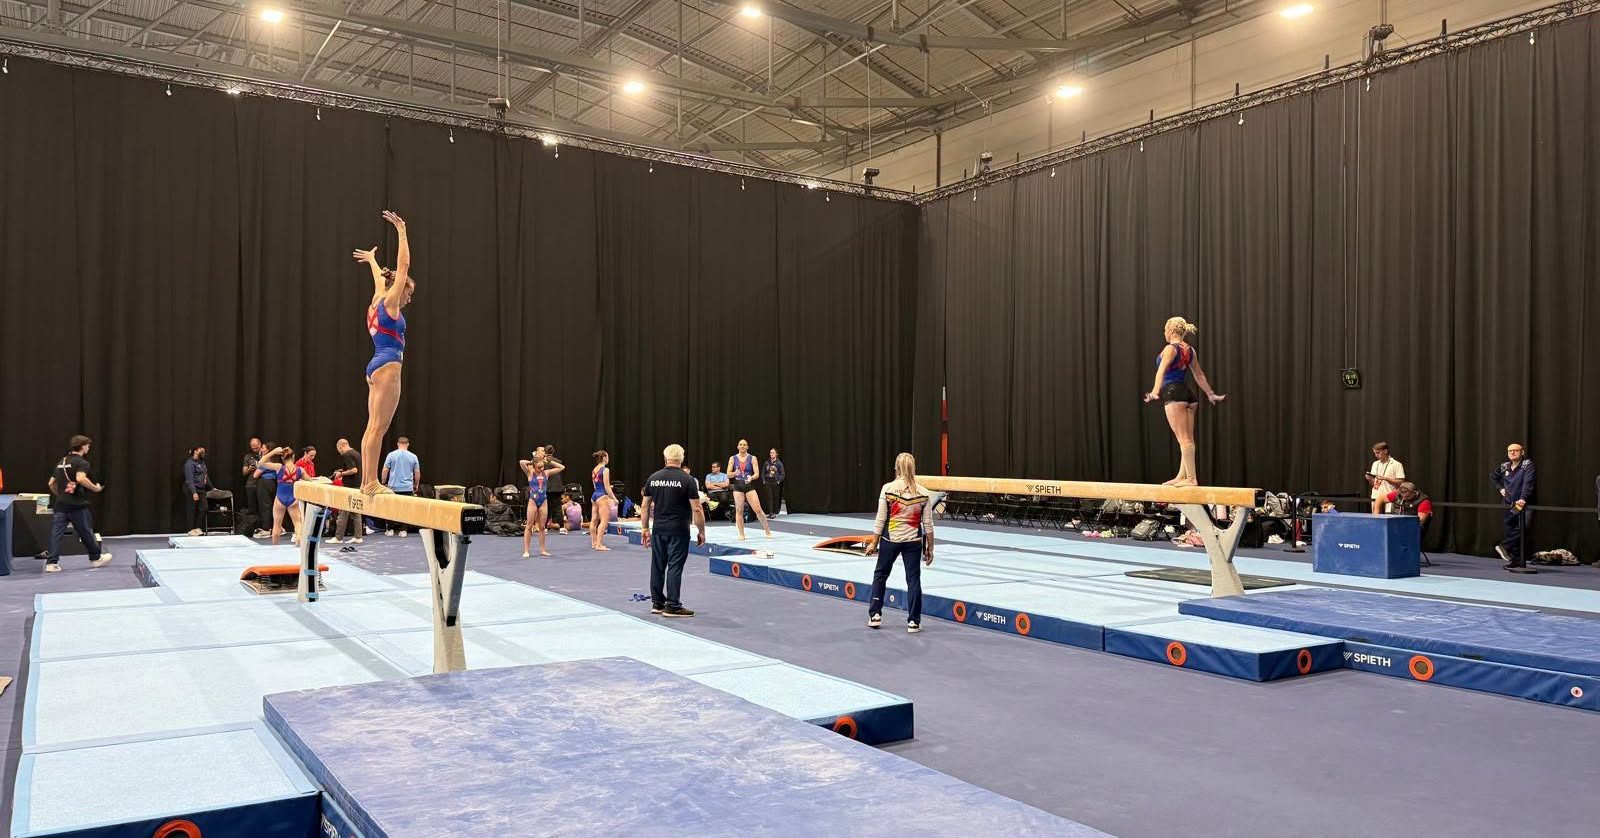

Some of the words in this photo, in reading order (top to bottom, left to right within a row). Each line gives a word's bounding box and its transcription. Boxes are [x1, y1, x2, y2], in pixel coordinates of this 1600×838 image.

[1035, 485, 1061, 494] SPIETH
[823, 583, 839, 592] SPIETH
[983, 612, 1006, 624] SPIETH
[1353, 653, 1391, 667] SPIETH
